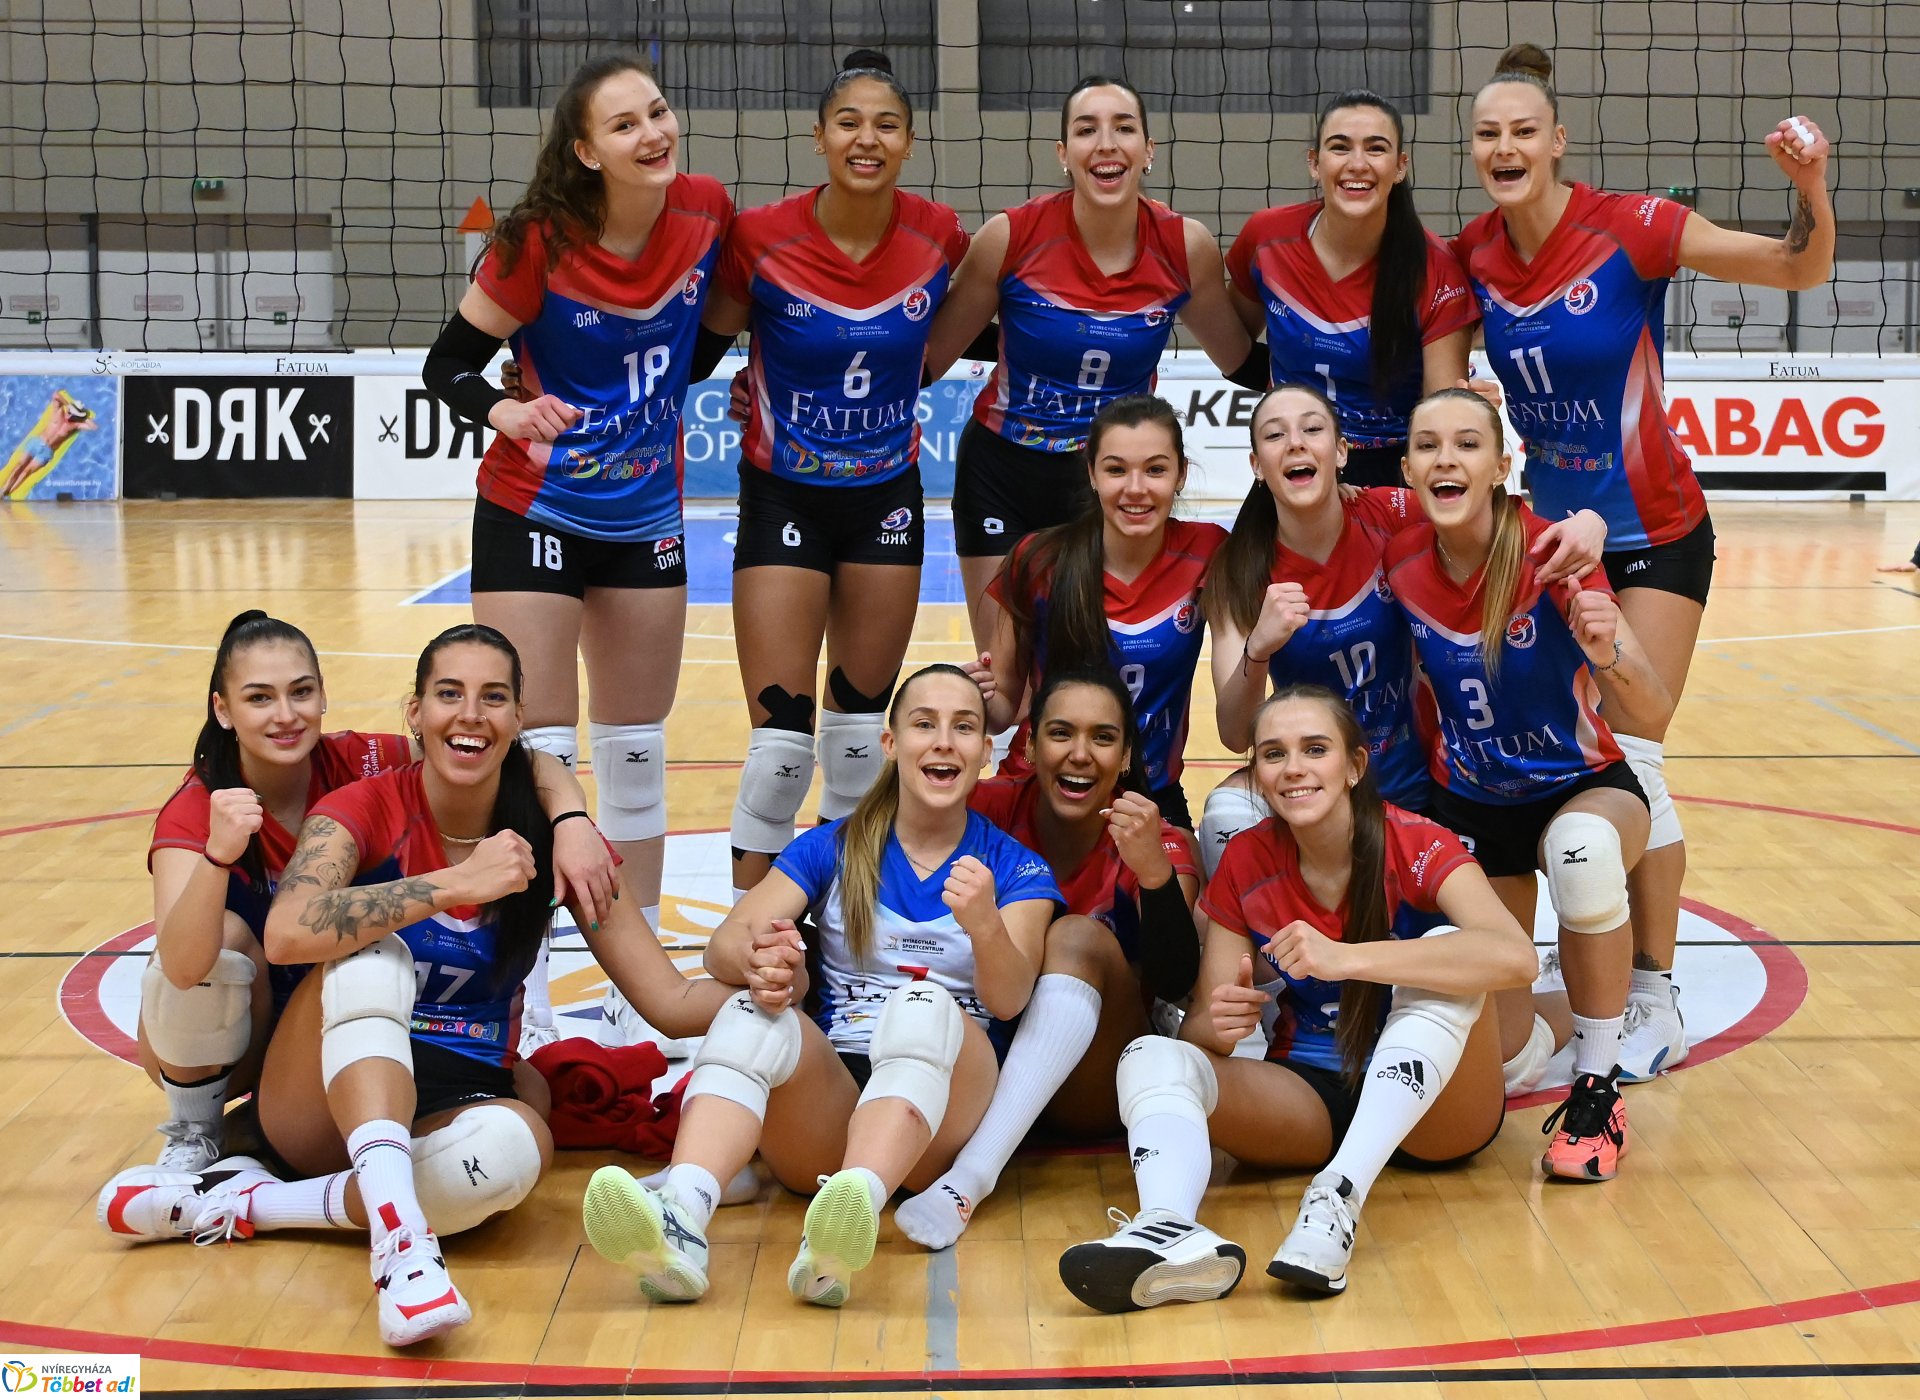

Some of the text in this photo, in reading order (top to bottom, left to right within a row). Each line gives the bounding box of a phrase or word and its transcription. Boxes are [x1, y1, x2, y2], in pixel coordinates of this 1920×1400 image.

[275, 357, 329, 373] FATUM
[623, 344, 670, 403] 18
[843, 351, 872, 398] 6
[1077, 349, 1111, 391] 8
[1509, 346, 1553, 394] 11
[1769, 362, 1820, 377] FATUM
[788, 389, 907, 432] FATUM
[528, 531, 563, 571] 18
[783, 521, 802, 548] 6
[1328, 640, 1376, 690] 10
[1459, 678, 1494, 730] 3
[414, 961, 476, 1004] 17
[469, 1021, 500, 1041] ad!
[1376, 1069, 1426, 1100] adidas
